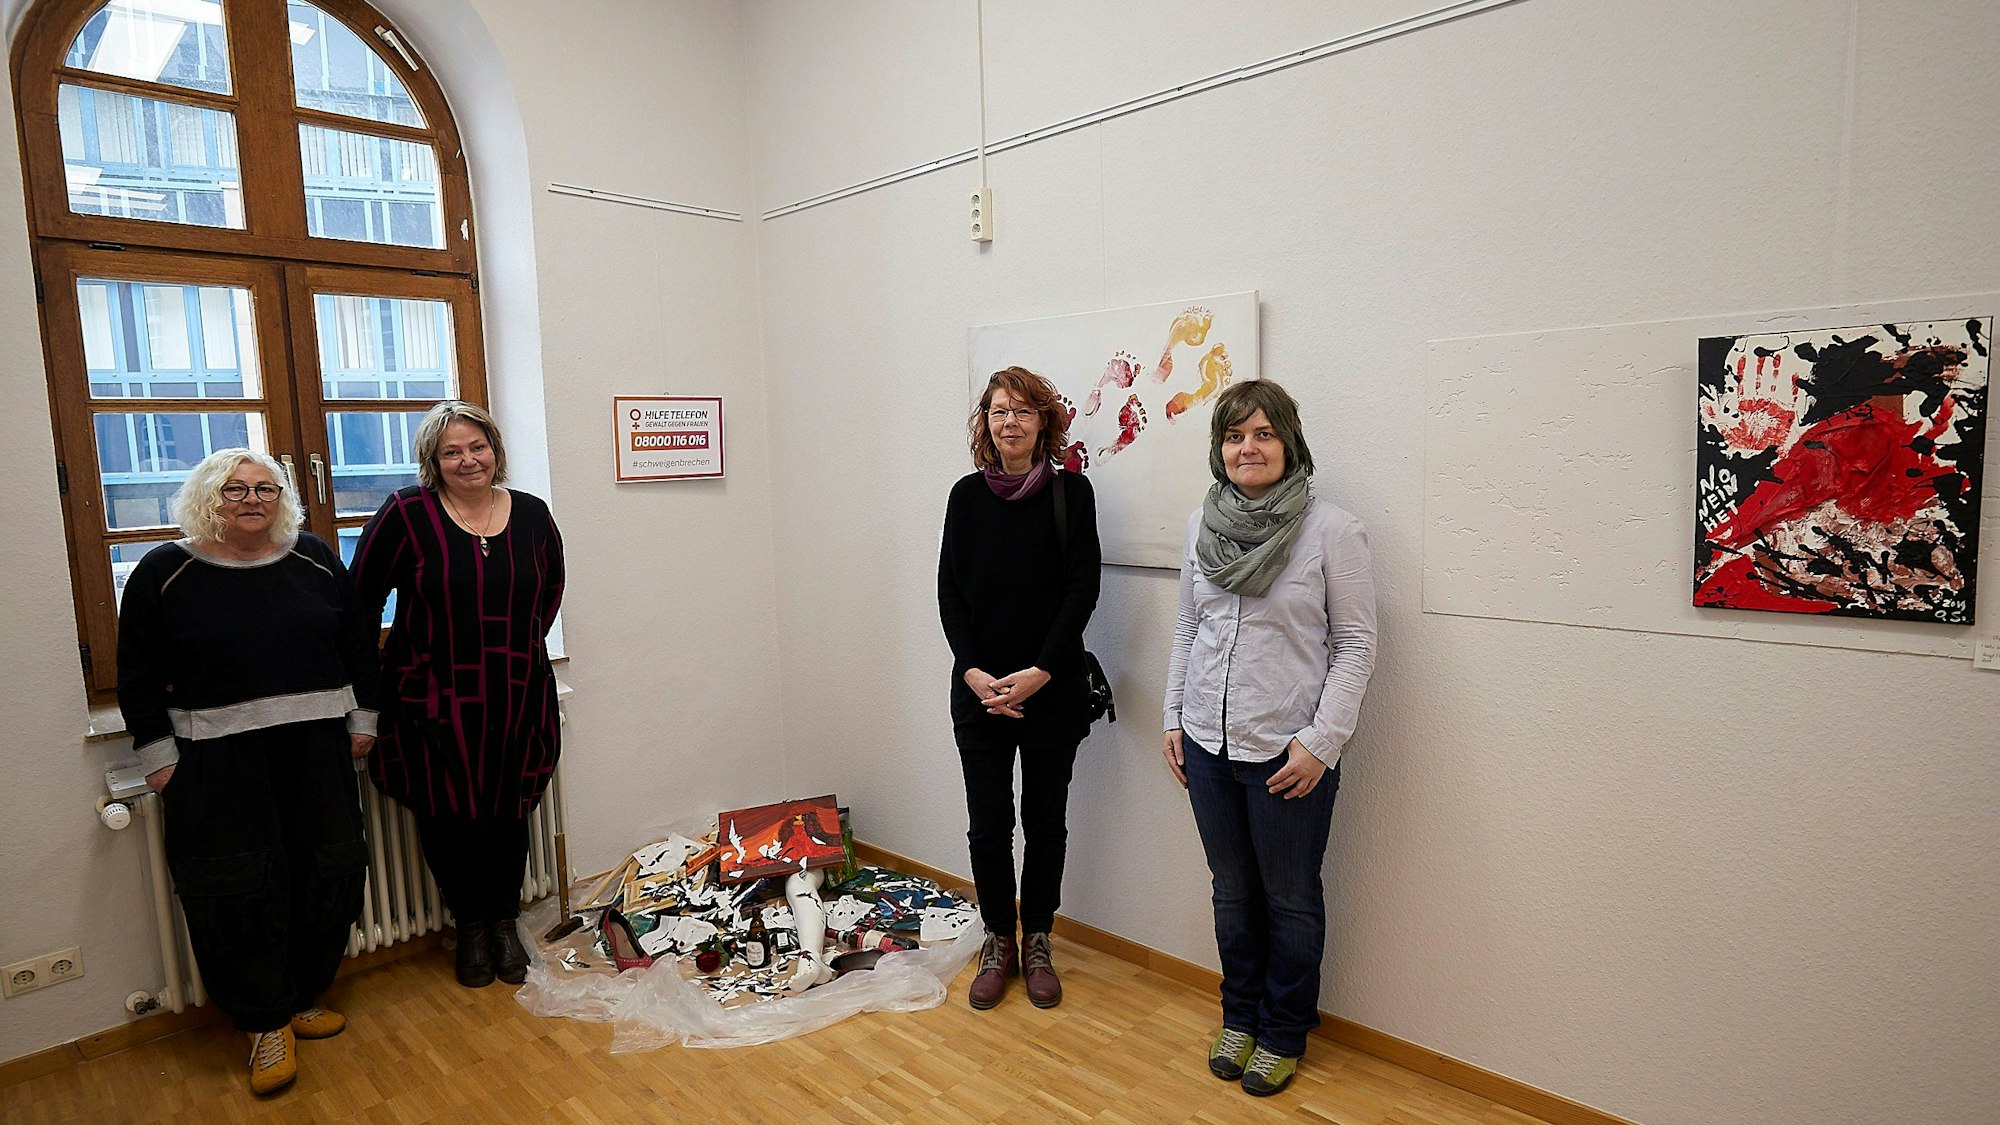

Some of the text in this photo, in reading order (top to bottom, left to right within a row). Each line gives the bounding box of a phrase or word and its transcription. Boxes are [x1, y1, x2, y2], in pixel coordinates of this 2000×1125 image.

[644, 410, 708, 420] HILFE TELEFON
[634, 434, 706, 447] 08000 116 016
[632, 458, 710, 468] #schweigenbrechen
[1700, 464, 1731, 495] NO
